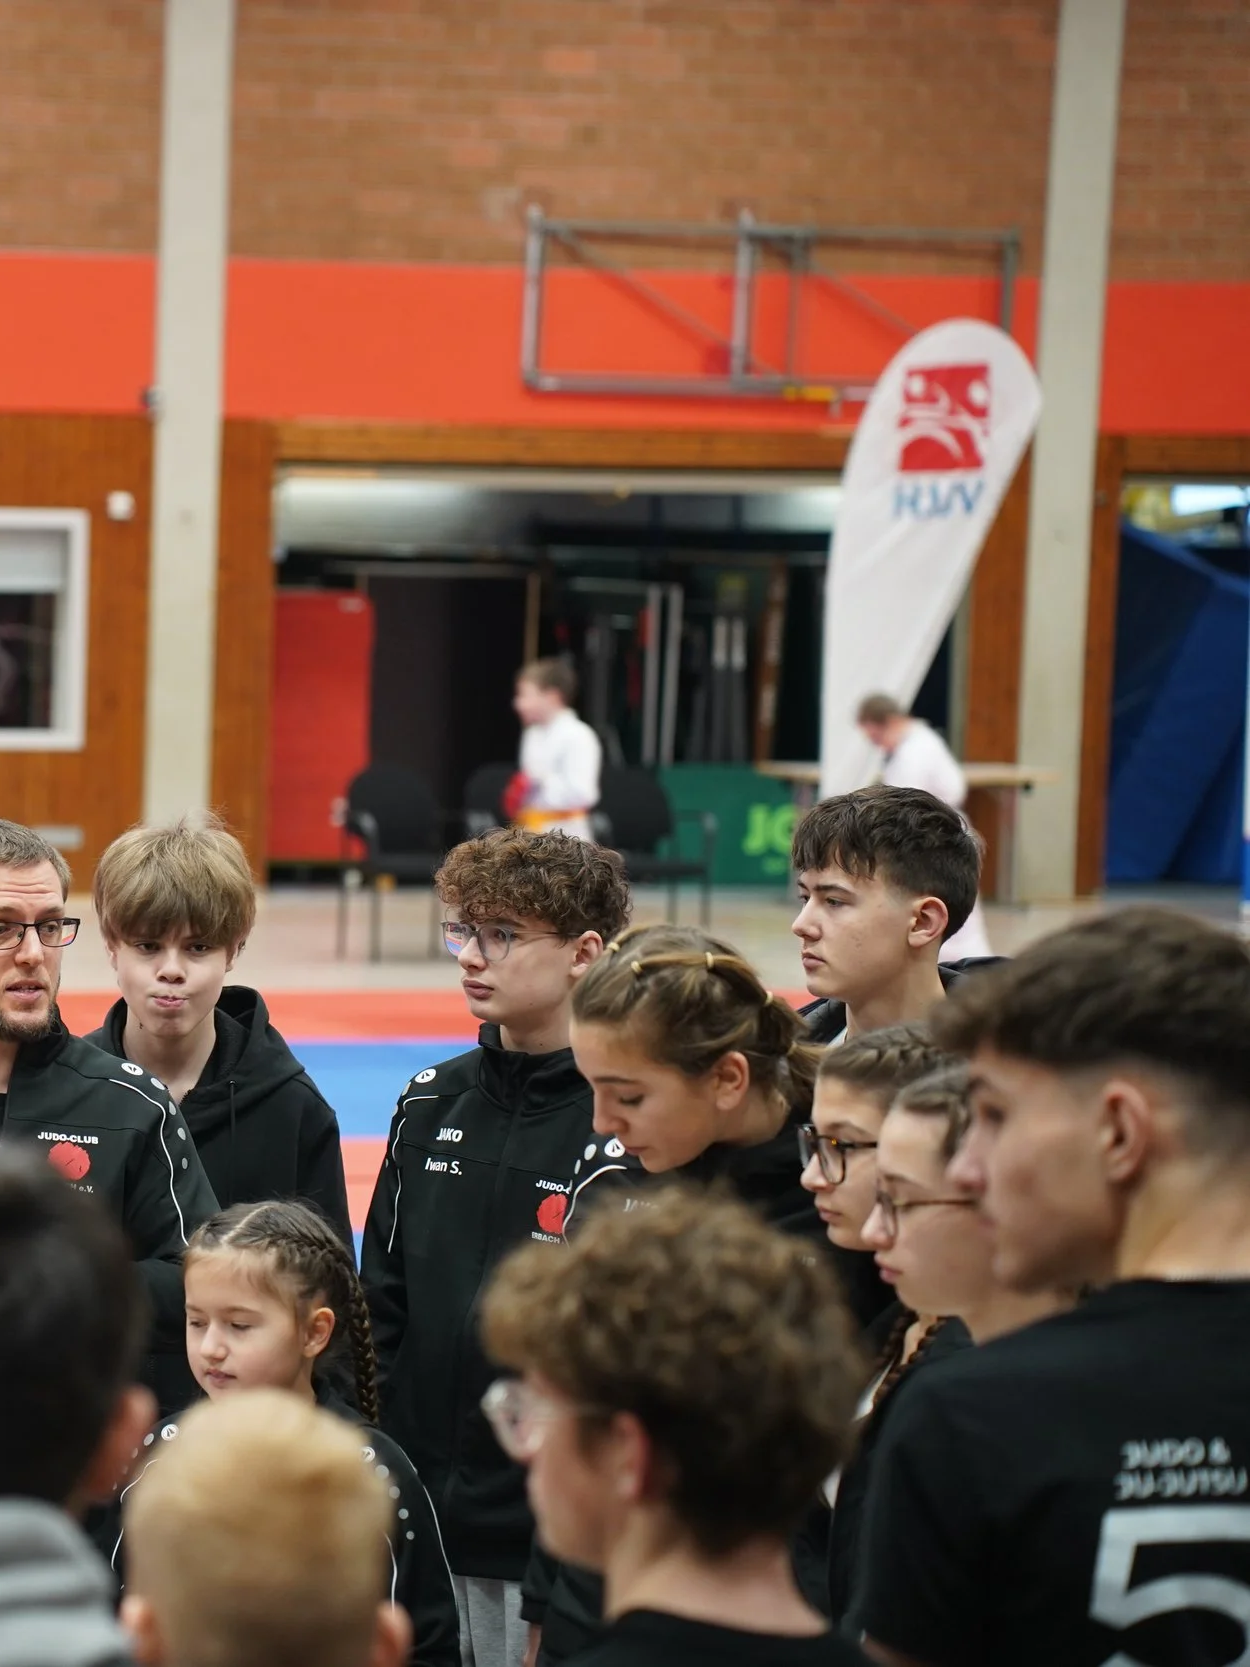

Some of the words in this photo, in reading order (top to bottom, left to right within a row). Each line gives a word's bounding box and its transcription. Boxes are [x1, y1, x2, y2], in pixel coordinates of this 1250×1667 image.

[37, 1131, 99, 1145] JUDO-CLUB
[436, 1127, 463, 1142] JAKO
[424, 1157, 448, 1172] Iwan
[449, 1160, 463, 1176] S.
[1120, 1437, 1206, 1470] JUDO
[1208, 1437, 1231, 1465] &
